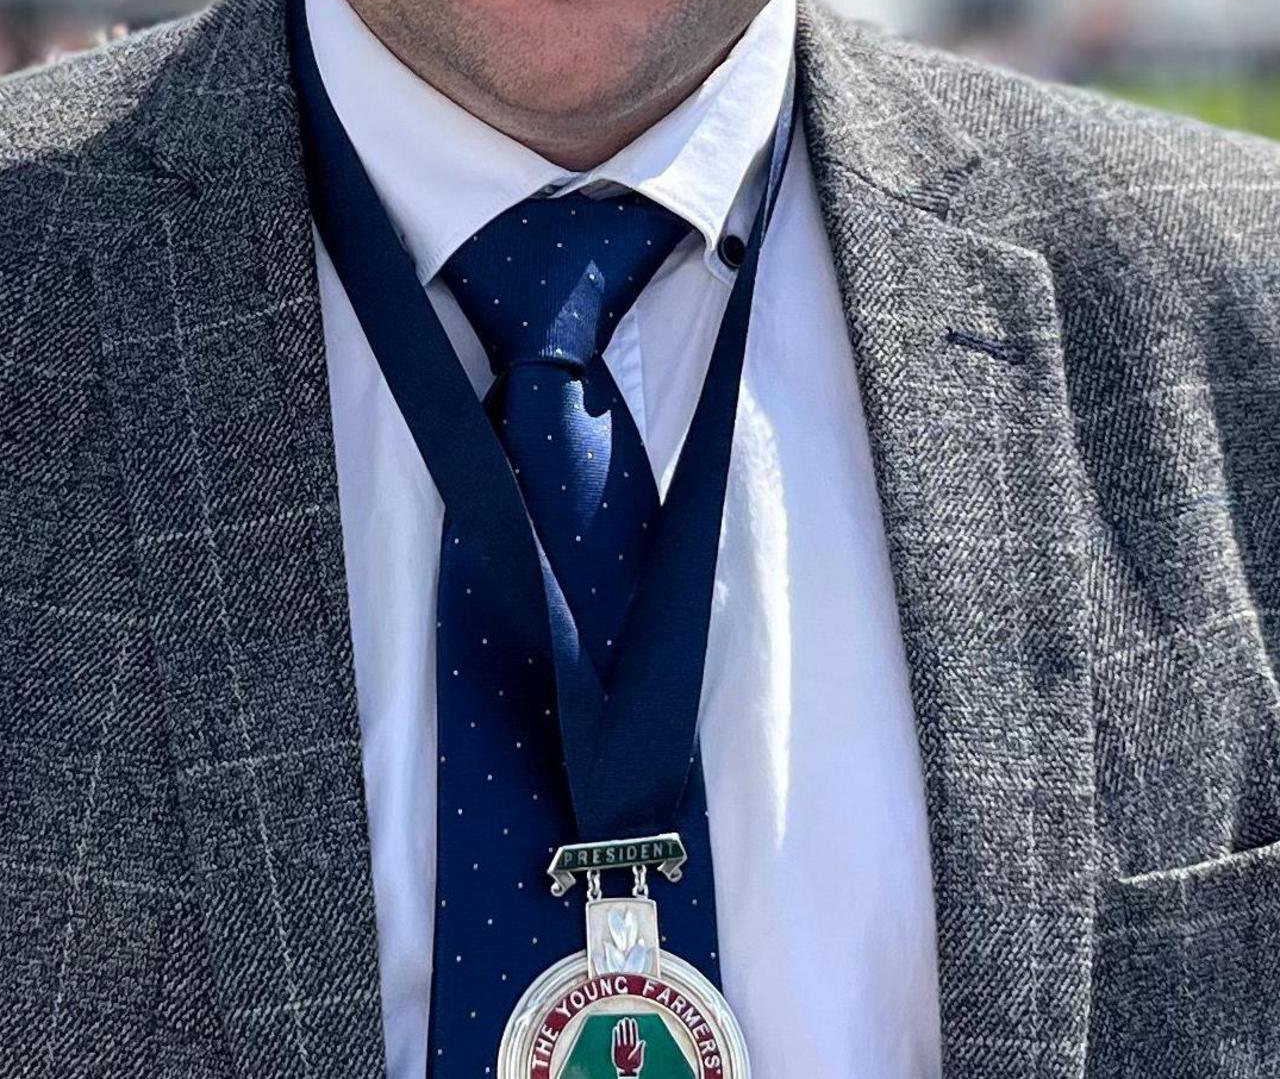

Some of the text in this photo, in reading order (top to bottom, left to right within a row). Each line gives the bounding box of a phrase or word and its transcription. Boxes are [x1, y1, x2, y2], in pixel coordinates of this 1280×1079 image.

[563, 841, 675, 866] PRESIDENT
[531, 1025, 560, 1070] THE
[555, 976, 629, 1018] YOUNG
